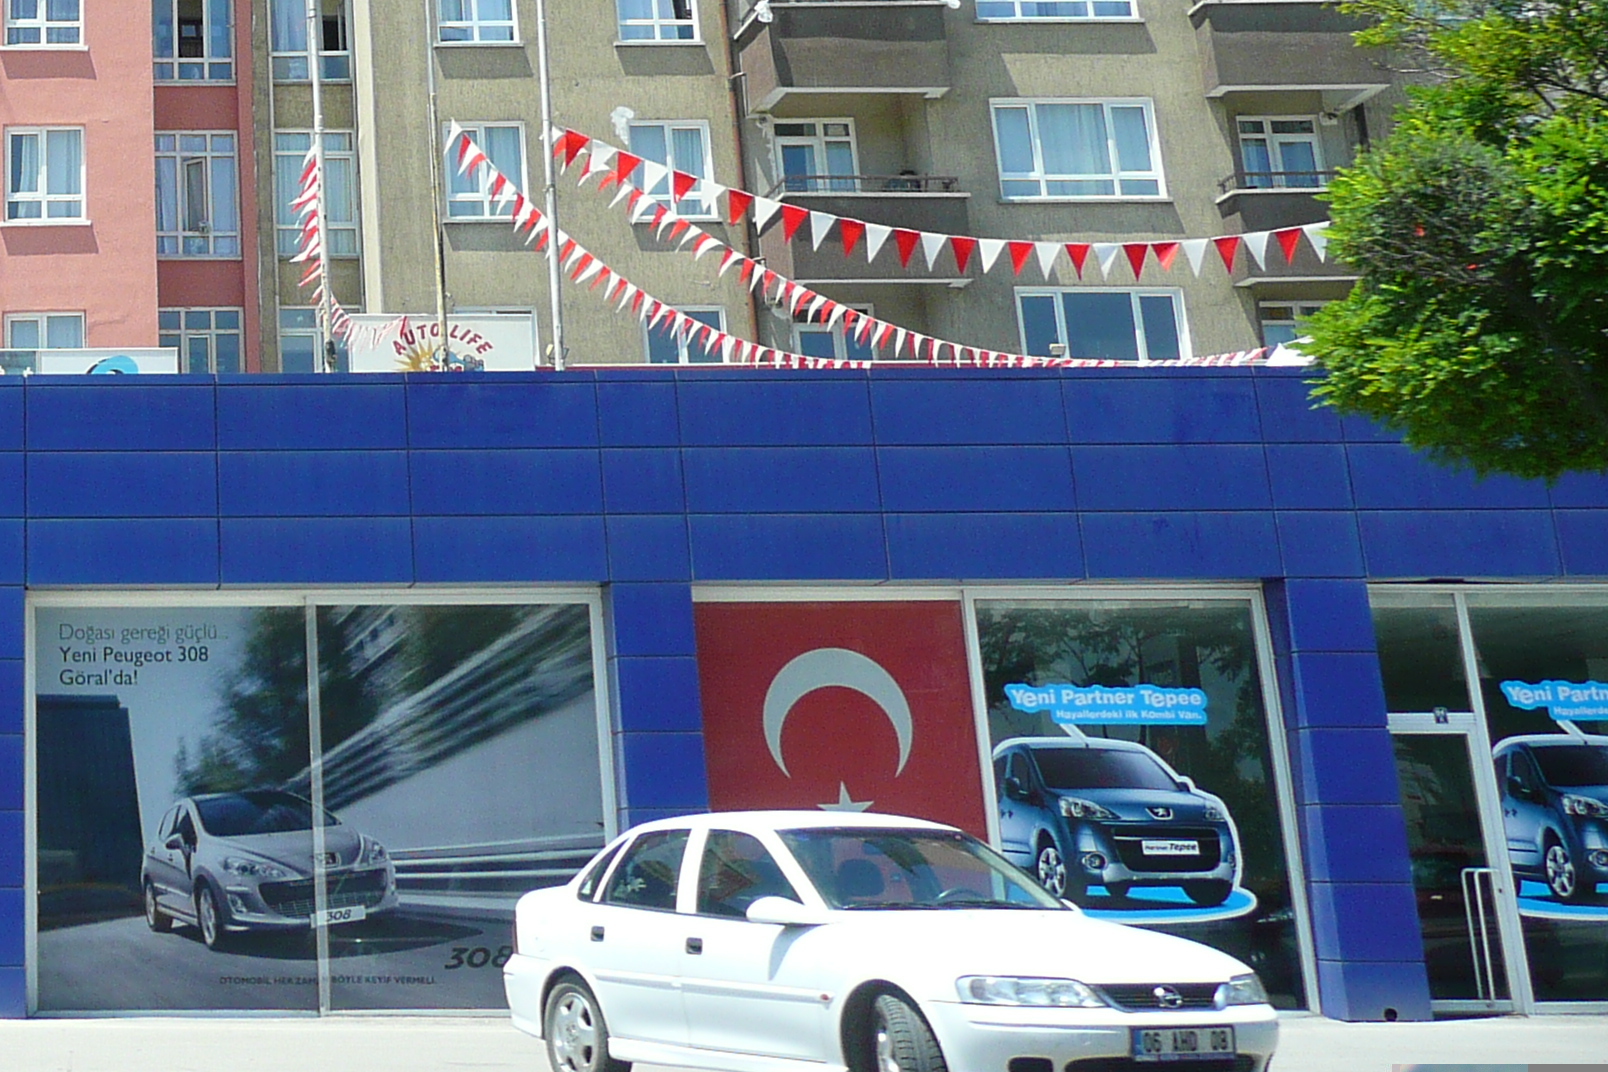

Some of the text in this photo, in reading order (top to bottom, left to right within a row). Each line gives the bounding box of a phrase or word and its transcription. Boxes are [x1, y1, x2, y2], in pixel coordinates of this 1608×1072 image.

[393, 321, 494, 356] AUTO LIFE
[59, 623, 115, 645] Doğası
[120, 624, 170, 645] gereği
[59, 645, 209, 667] Yeni Peugeot 308
[59, 669, 138, 686] Göral'da!
[1010, 689, 1202, 708] Yeni Partner Tepee
[1506, 686, 1552, 705] Yeni
[326, 908, 352, 923] 308
[444, 944, 513, 970] 308
